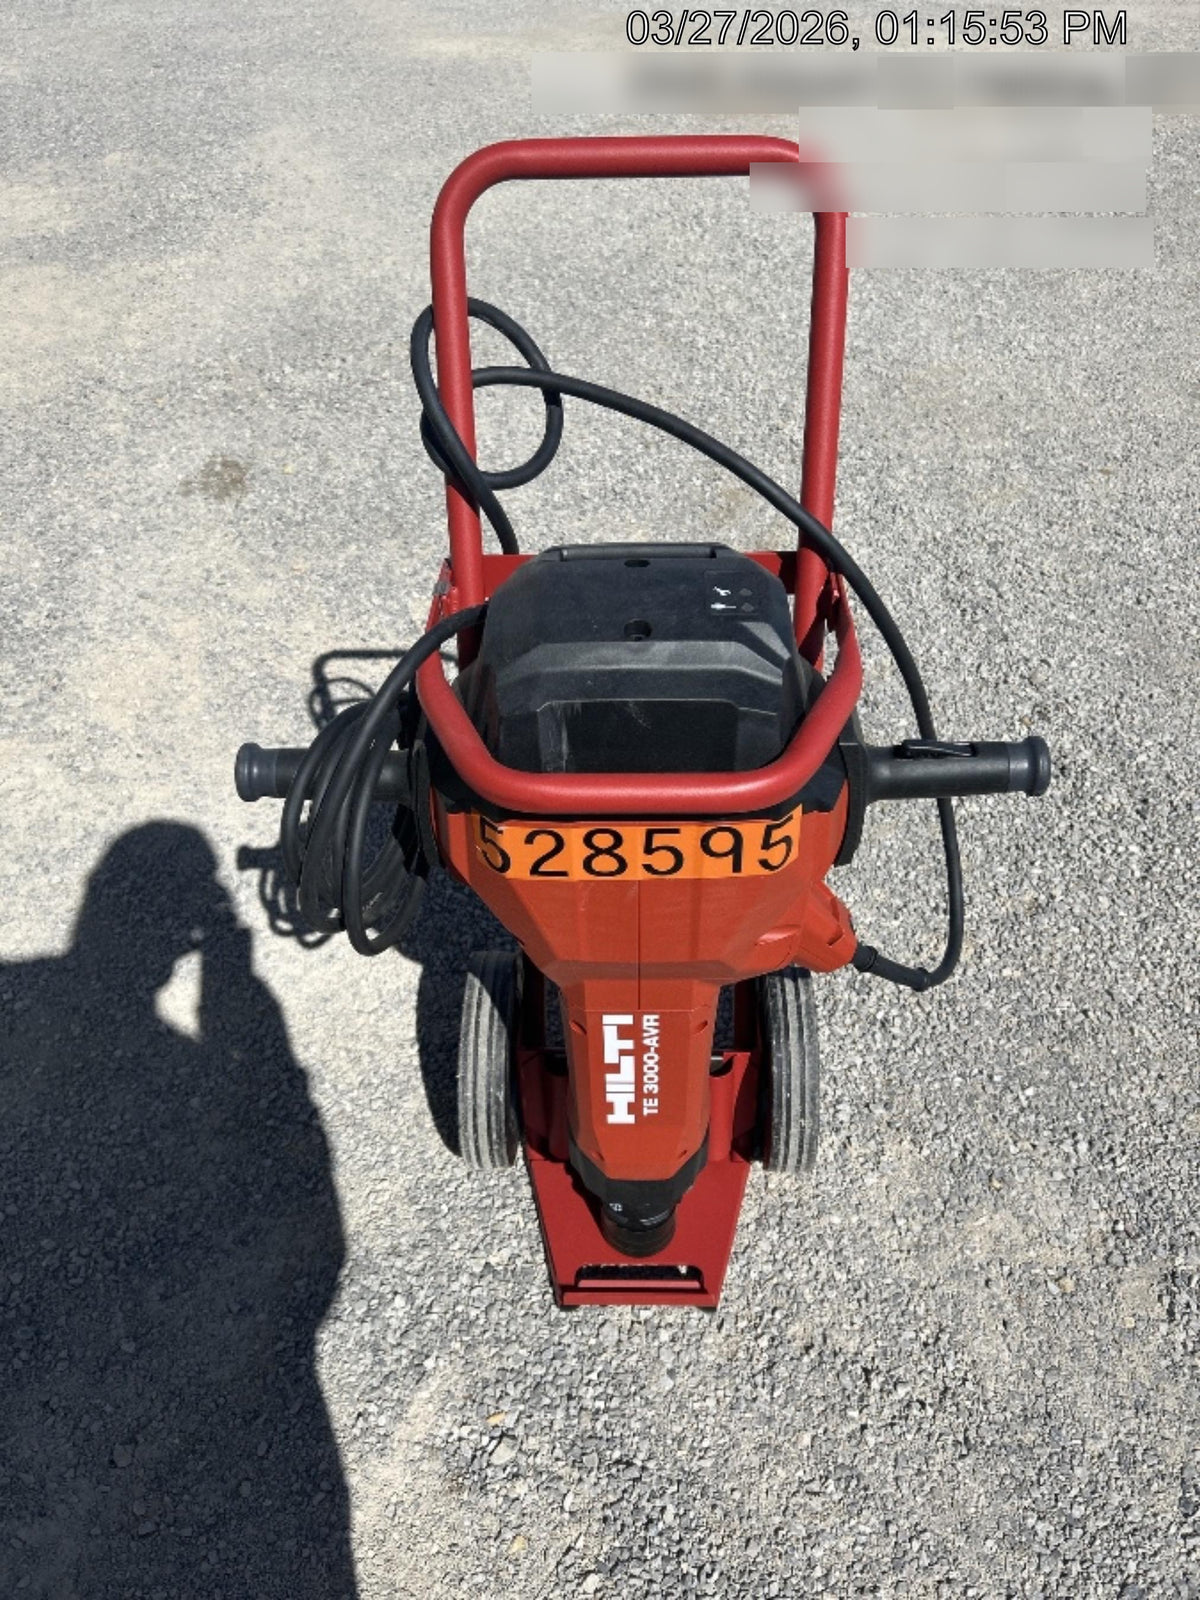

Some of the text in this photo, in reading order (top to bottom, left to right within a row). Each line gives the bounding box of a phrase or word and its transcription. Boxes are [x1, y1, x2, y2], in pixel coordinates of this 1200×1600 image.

[479, 814, 794, 878] 528595
[602, 1014, 636, 1124] HILTI
[642, 1014, 661, 1116] TE 3000-AVR
